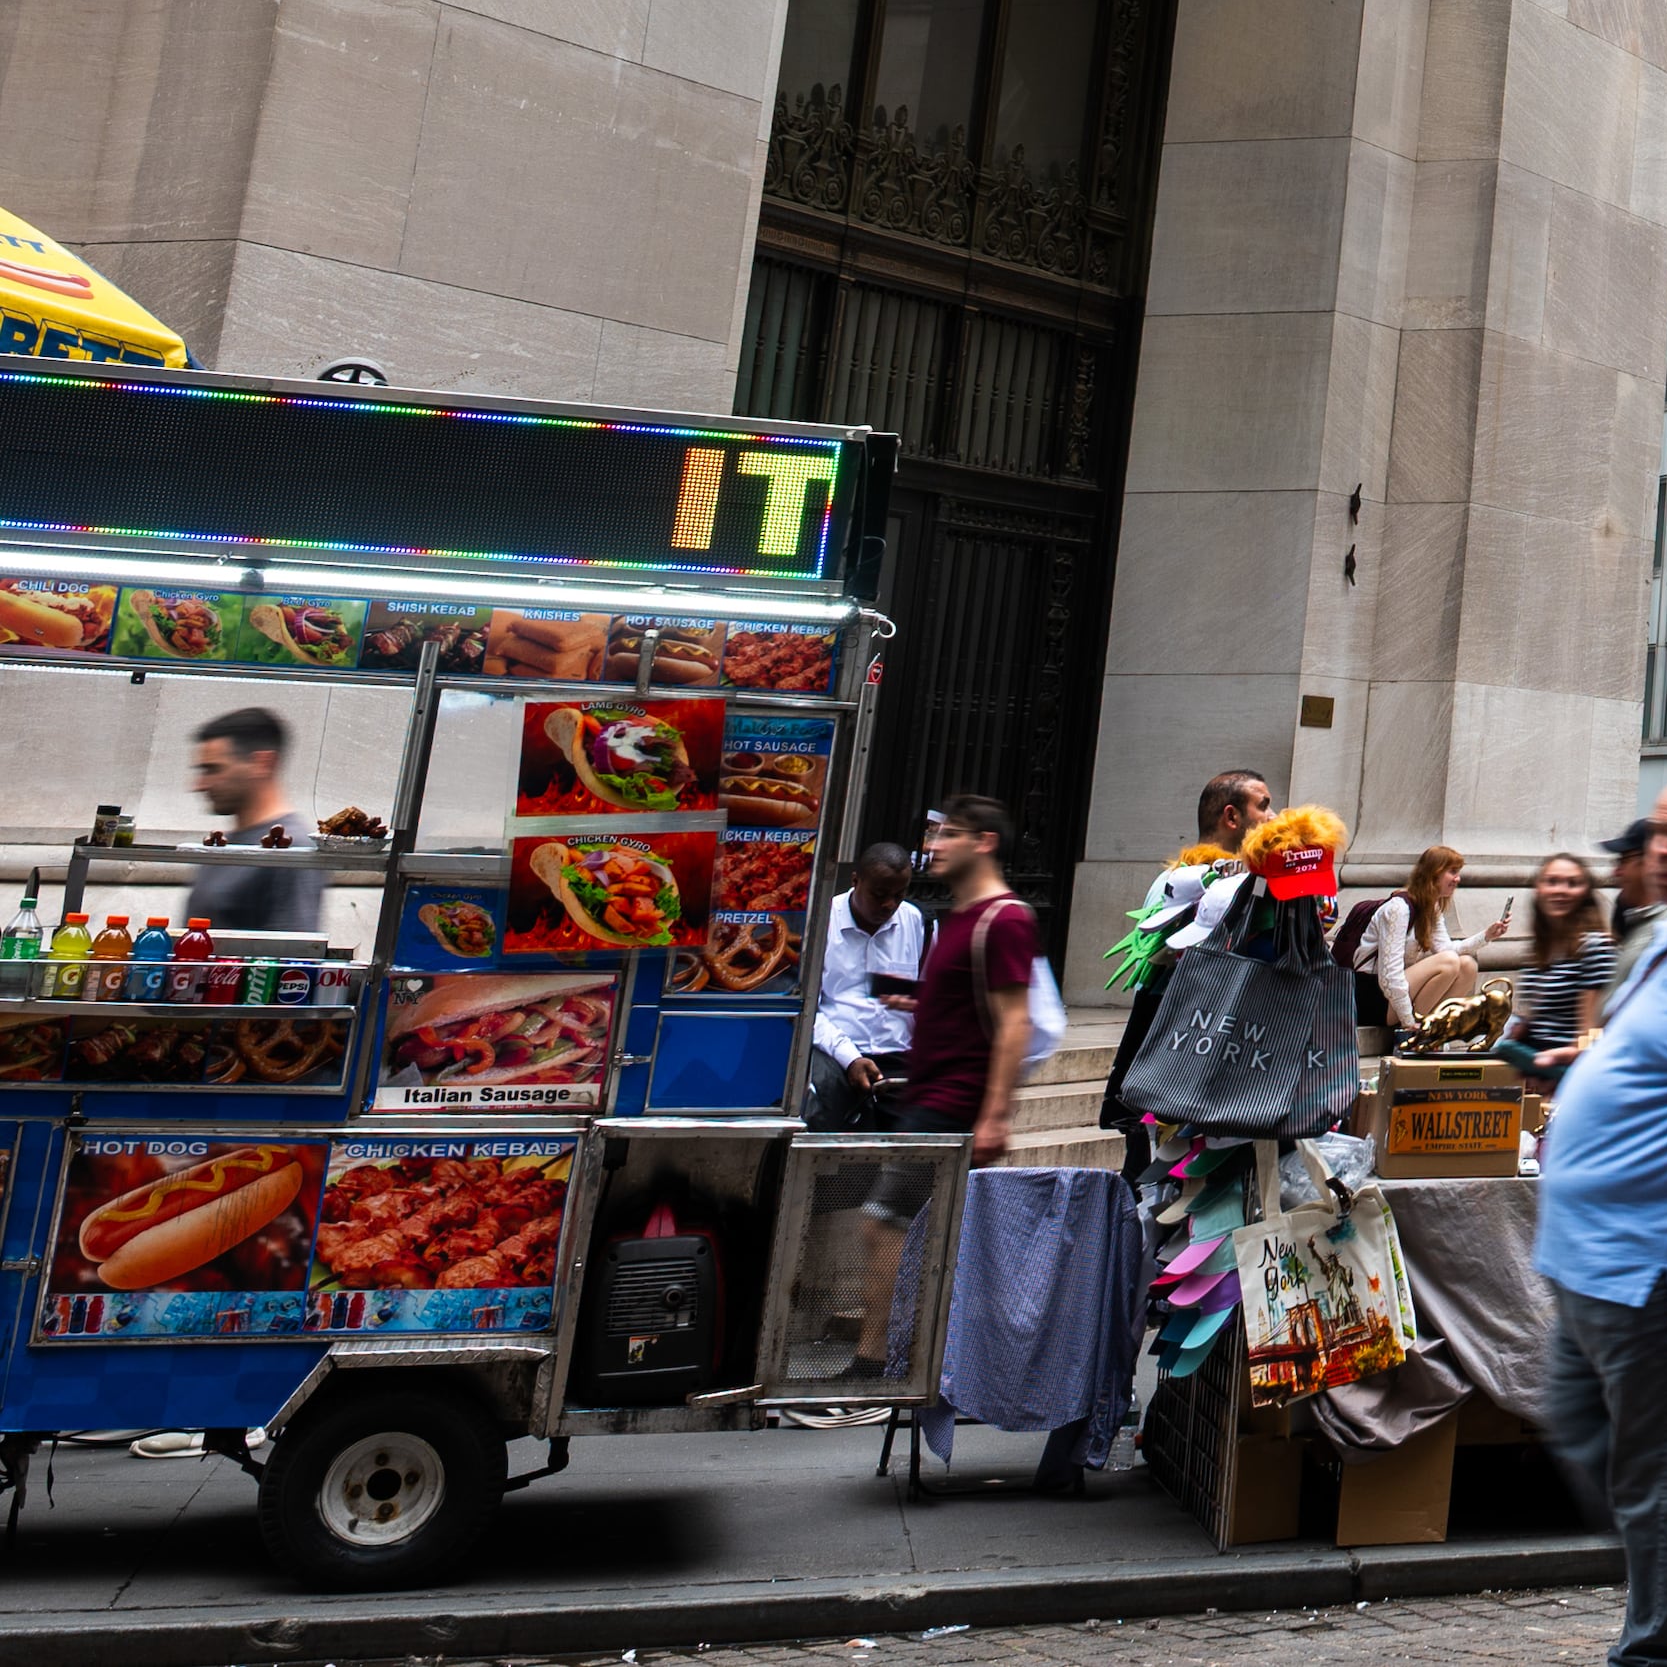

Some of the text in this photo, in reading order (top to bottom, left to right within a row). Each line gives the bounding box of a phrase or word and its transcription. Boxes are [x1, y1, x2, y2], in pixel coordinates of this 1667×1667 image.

[671, 447, 836, 557] IT
[18, 580, 90, 594] CHILI DOG
[153, 589, 220, 603] Chicken Gyro
[282, 596, 332, 608] Beef Gyro
[387, 601, 477, 617] SHISH KEBAB
[524, 609, 580, 622] KNISHES
[626, 615, 715, 630] HOT SAUSAGE
[735, 621, 831, 636] CHICKEN KEBAB
[581, 701, 646, 717] LAMB GYRO
[723, 740, 817, 753] HOT SAUSAGE
[567, 835, 651, 853] CHICKEN GYRO
[764, 831, 811, 843] KEBAB
[1282, 848, 1324, 862] Trump
[1295, 865, 1318, 874] 2024
[715, 912, 774, 924] PRETZEL
[62, 967, 79, 985] G
[105, 972, 122, 990] G
[146, 971, 163, 988] G
[173, 973, 190, 990] G
[279, 979, 308, 991] PEPSI
[392, 992, 423, 1005] NY
[1190, 1009, 1266, 1043] NEW
[1172, 1031, 1272, 1071] YORK
[1307, 1050, 1325, 1069] K
[404, 1087, 571, 1103] Italian Sausage
[1427, 1090, 1488, 1101] NEW YORK
[1411, 1110, 1512, 1141] WALLSTREET
[83, 1140, 208, 1156] HOT DOG
[346, 1141, 562, 1158] CHICKEN KEBAB
[1458, 1142, 1482, 1150] STATE
[1257, 1236, 1297, 1269] New
